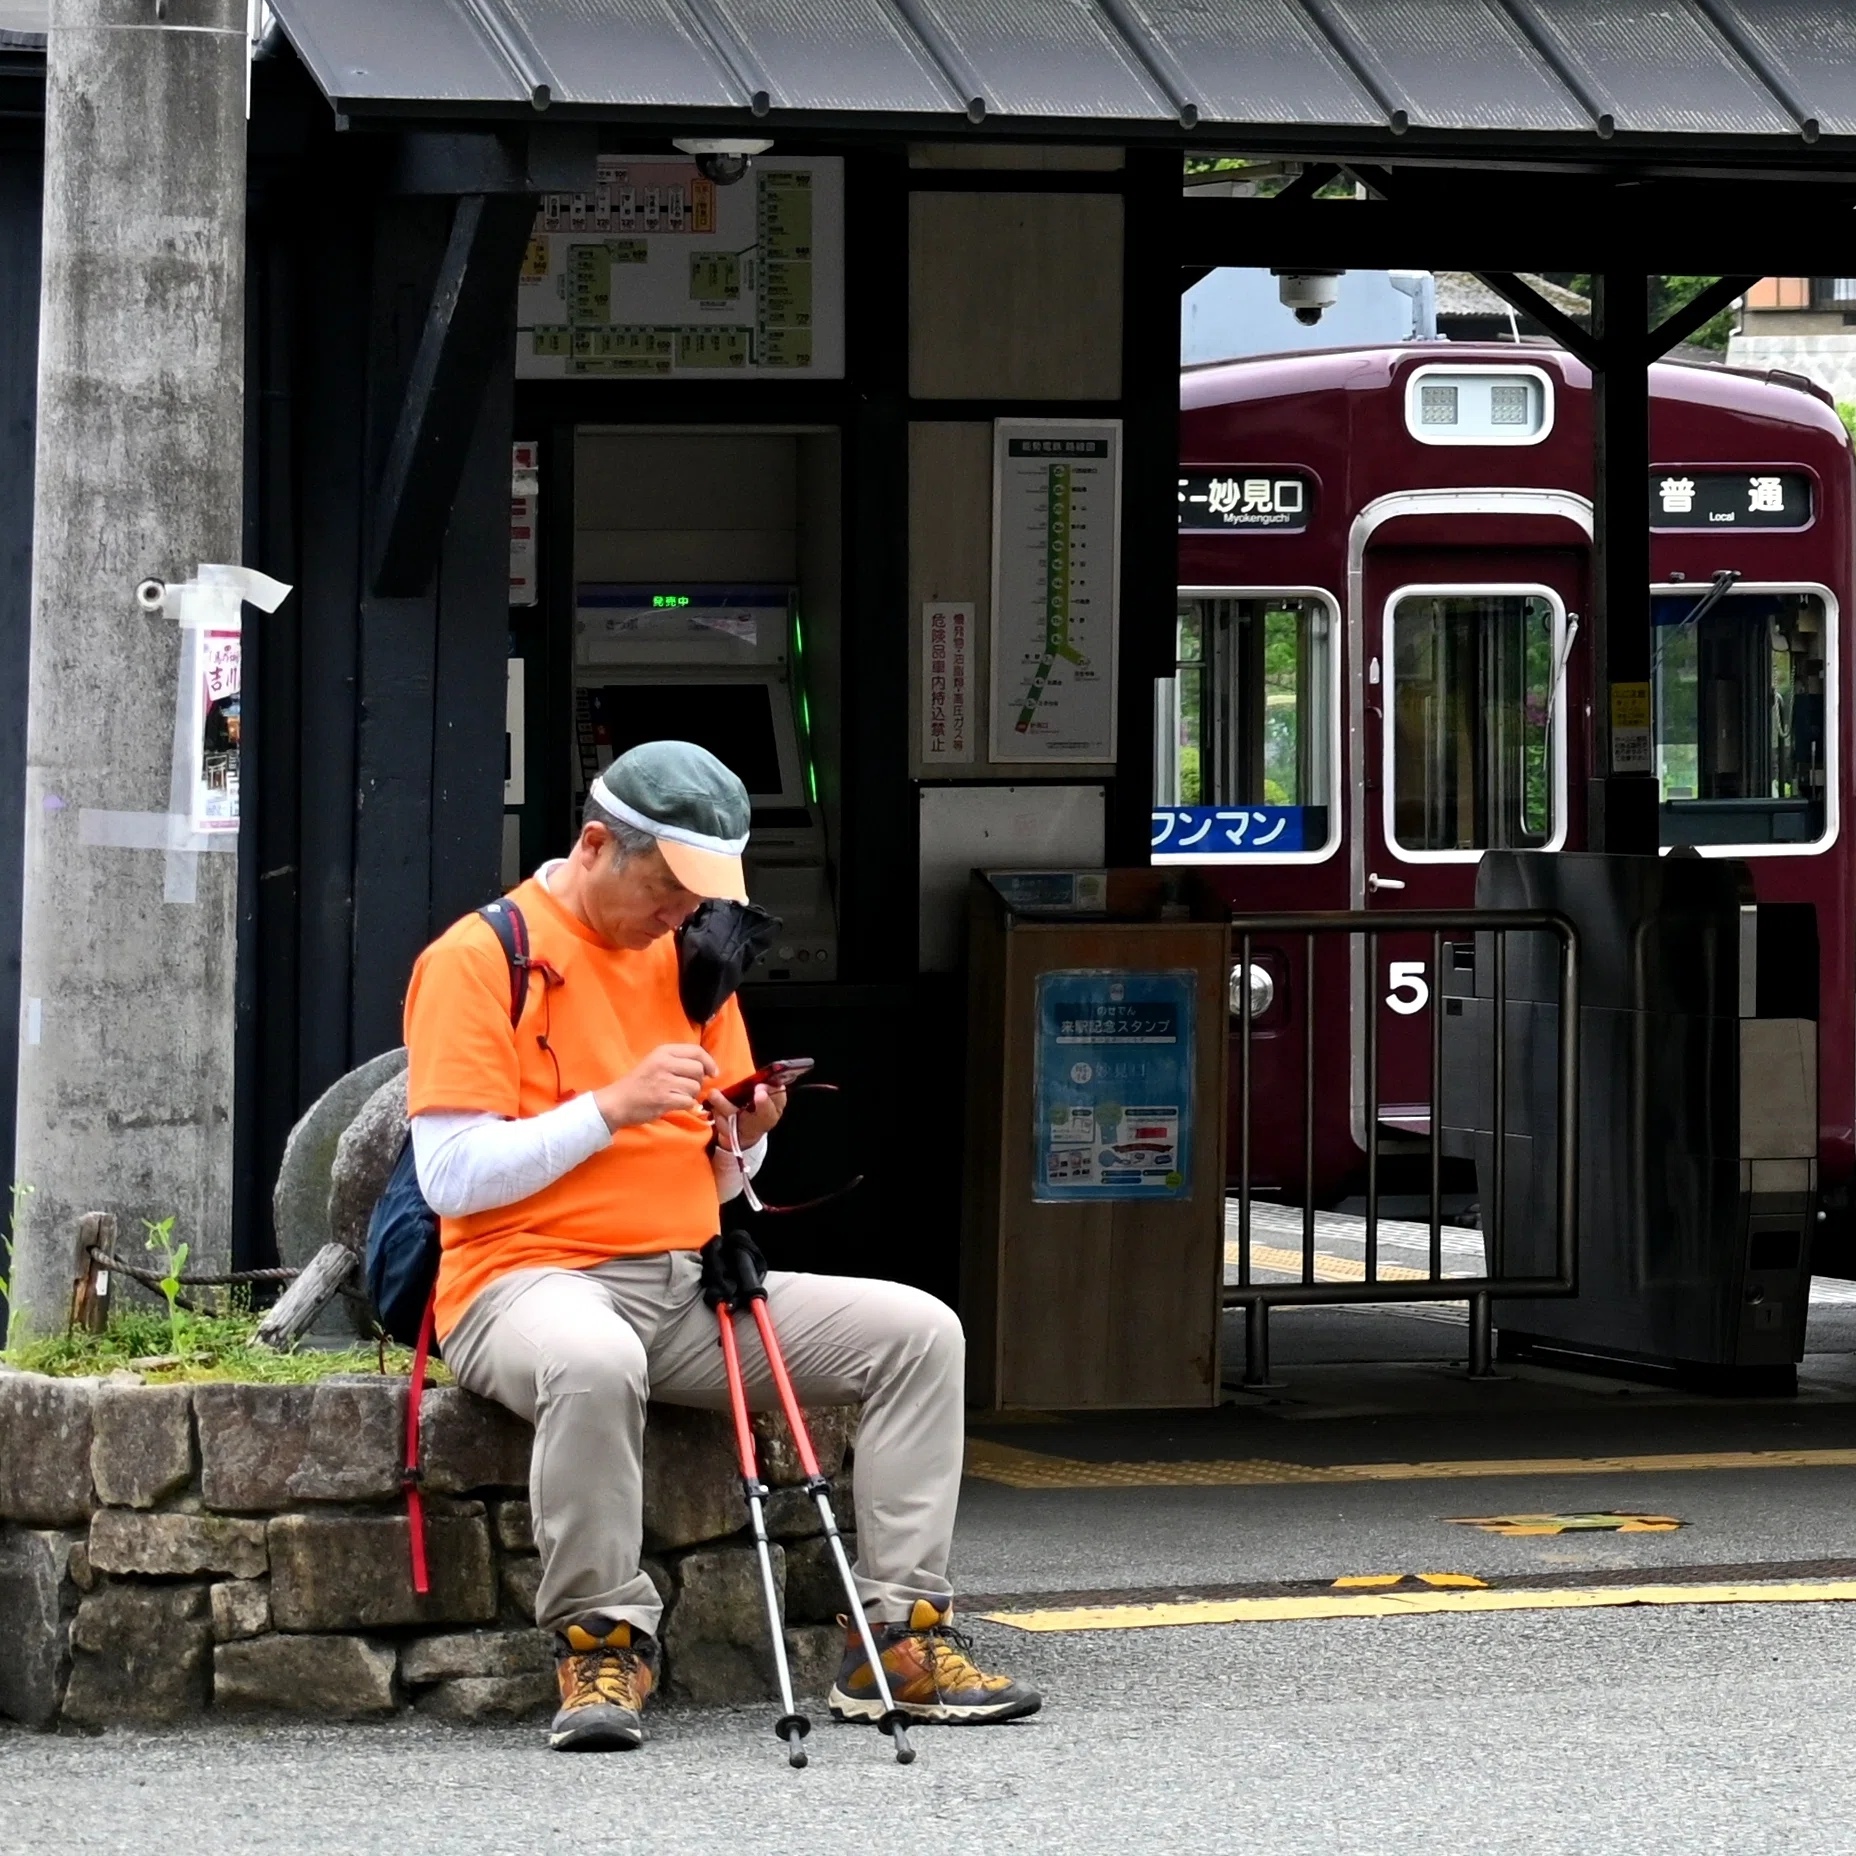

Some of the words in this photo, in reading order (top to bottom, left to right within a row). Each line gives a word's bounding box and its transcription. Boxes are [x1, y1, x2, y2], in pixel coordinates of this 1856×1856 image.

[1659, 477, 1785, 513] 普通
[1223, 513, 1291, 526] Myokenguchi
[1709, 511, 1735, 522] Local
[653, 595, 689, 607] 発売中
[931, 613, 946, 753] 危険品車内持込禁止
[1384, 962, 1429, 1015] 5
[1096, 1006, 1137, 1017] のせでん
[1061, 1019, 1171, 1034] 来駅記念スタンプ
[1095, 1062, 1146, 1078] 妙見口
